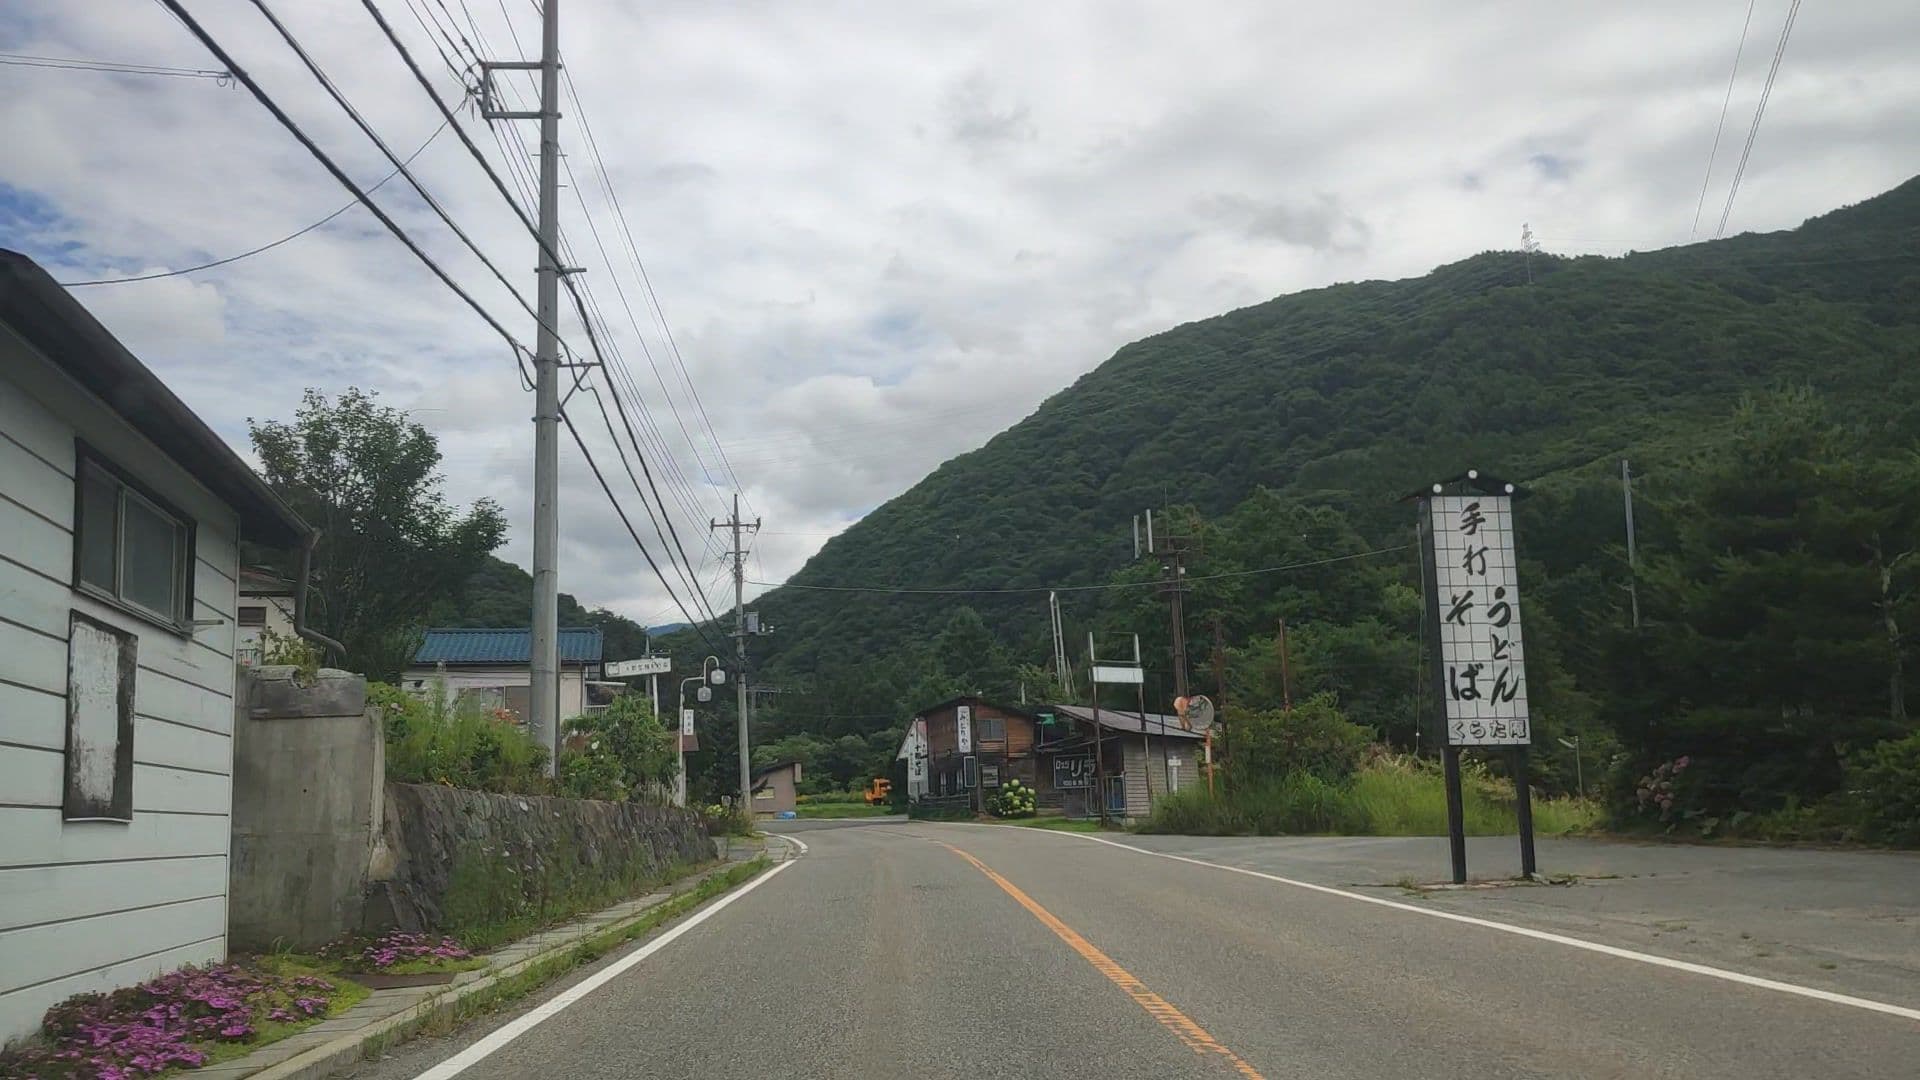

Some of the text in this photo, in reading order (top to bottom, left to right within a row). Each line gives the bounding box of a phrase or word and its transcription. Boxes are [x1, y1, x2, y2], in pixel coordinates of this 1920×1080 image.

[1459, 502, 1488, 576] 手打
[1445, 590, 1484, 702] そば
[1487, 586, 1519, 706] うどん
